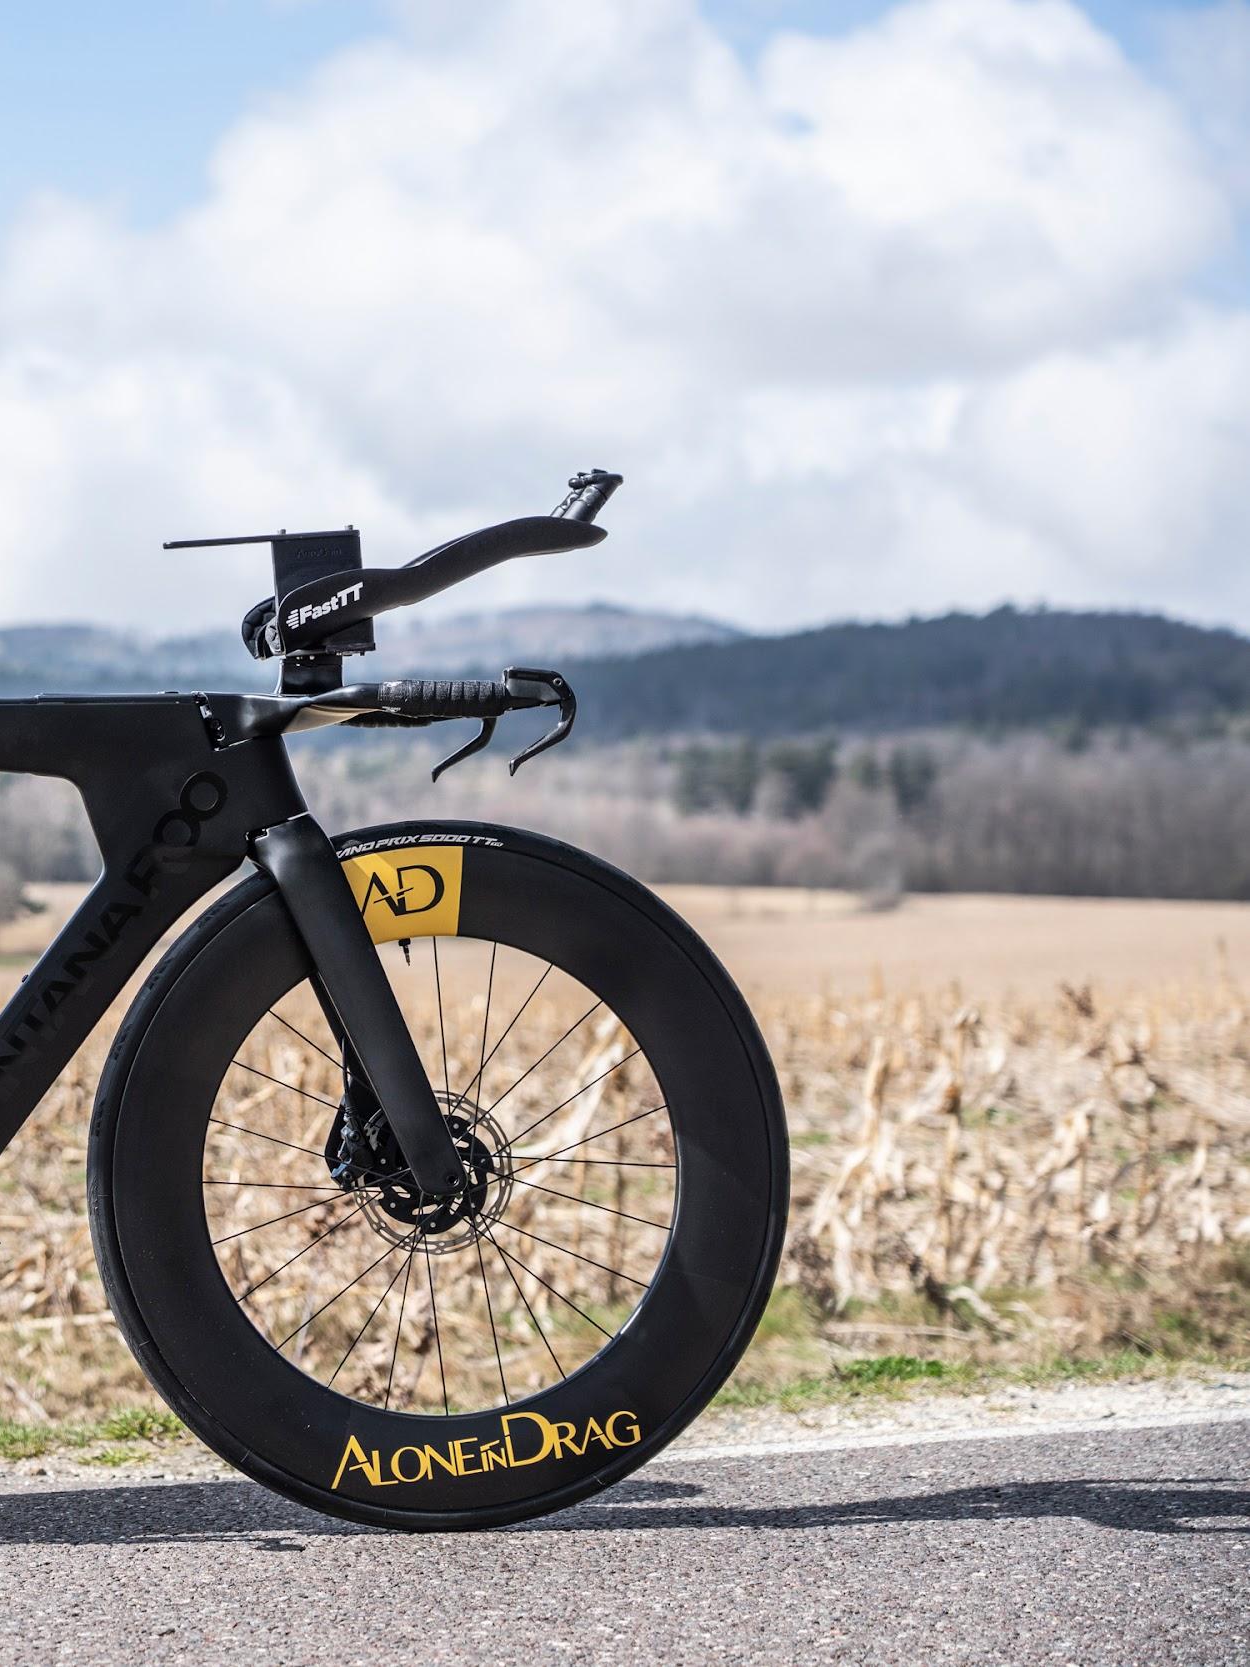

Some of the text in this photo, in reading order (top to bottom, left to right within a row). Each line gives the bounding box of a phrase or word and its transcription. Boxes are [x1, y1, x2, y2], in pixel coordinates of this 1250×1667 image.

[299, 582, 364, 625] FastTT
[375, 834, 420, 849] PRIX
[418, 834, 471, 843] 5000
